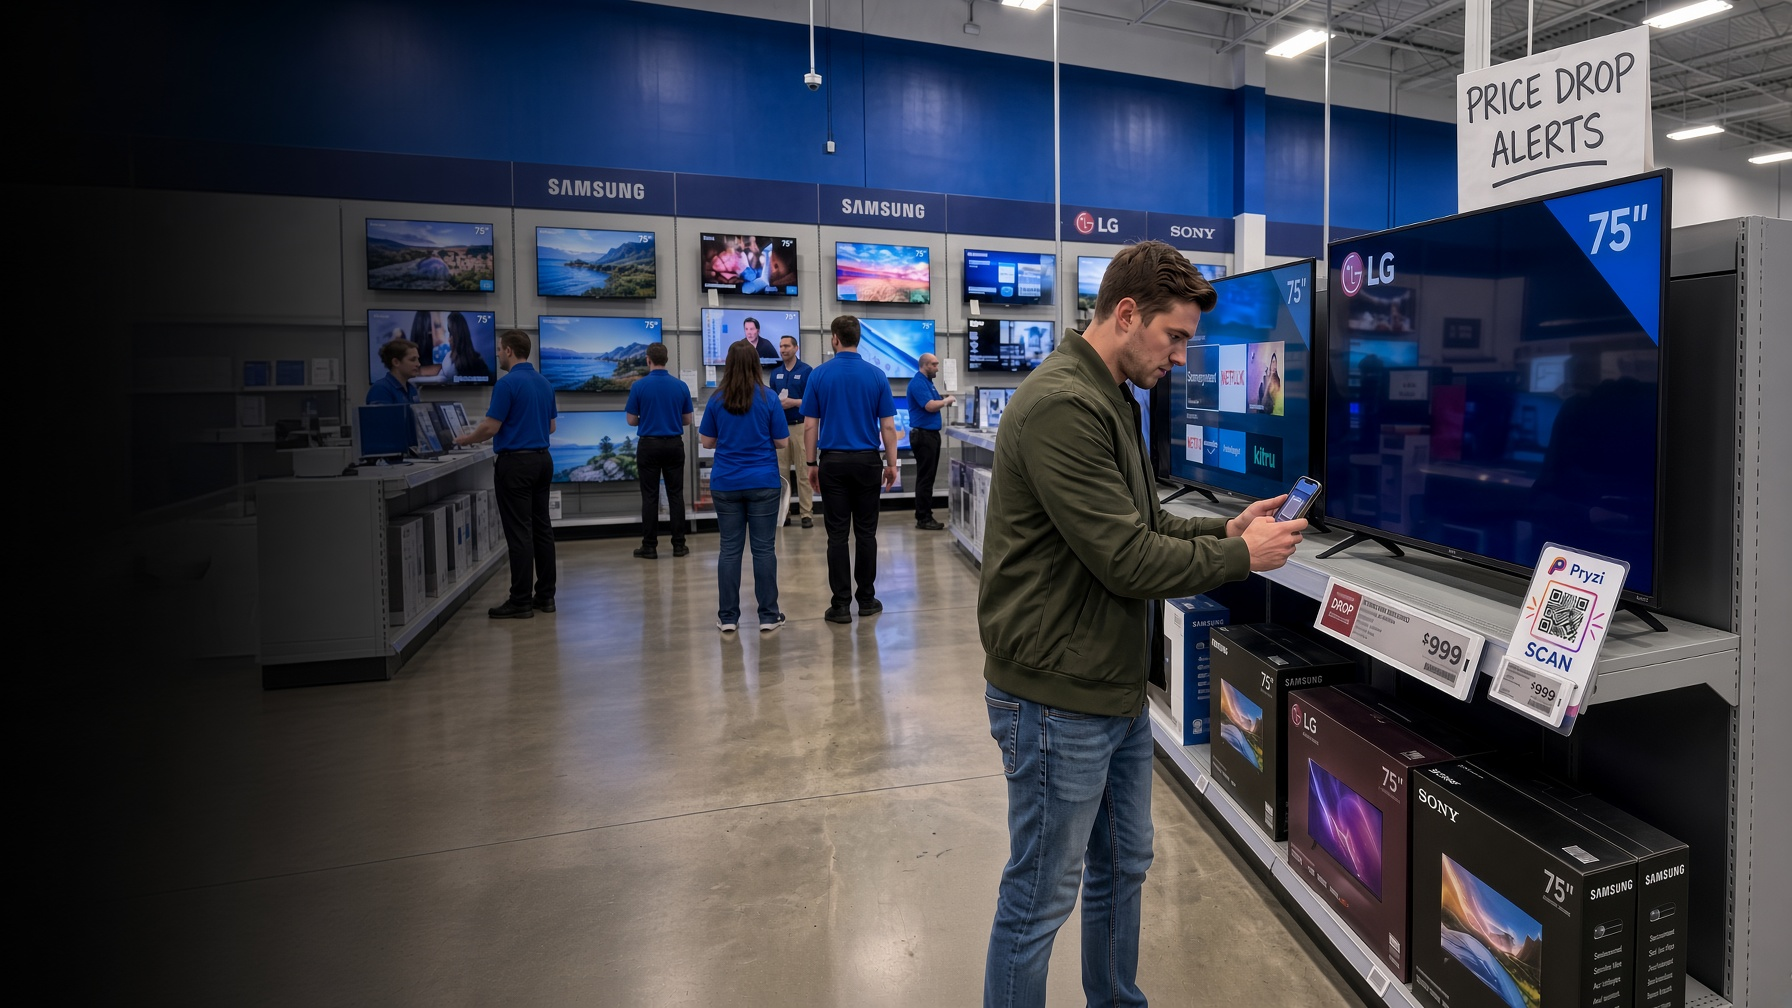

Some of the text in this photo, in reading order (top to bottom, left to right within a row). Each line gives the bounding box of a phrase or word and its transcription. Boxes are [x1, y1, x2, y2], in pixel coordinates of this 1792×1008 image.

[1466, 51, 1636, 124] PRICE DROP
[1490, 111, 1605, 169] ALERTS
[547, 177, 646, 201] SAMSUNG
[841, 198, 926, 220] SAMSUNG
[1097, 216, 1120, 234] LG
[1170, 224, 1216, 240] SONY
[1588, 202, 1649, 256] 75"
[1366, 251, 1396, 287] LG
[1286, 276, 1307, 305] 75"
[1569, 563, 1606, 586] Pryzi
[1330, 596, 1355, 618] DROP
[1421, 631, 1464, 667] $999
[1523, 640, 1574, 674] SCAN
[1284, 674, 1324, 688] SAMSUNG
[1529, 680, 1557, 702] $999
[1302, 711, 1318, 735] LG
[1380, 764, 1405, 794] 75"
[1417, 786, 1461, 825] SONY
[1542, 868, 1576, 904] 75"
[1644, 862, 1687, 887] SAMSUNG
[1589, 878, 1635, 902] SAMSUNG
